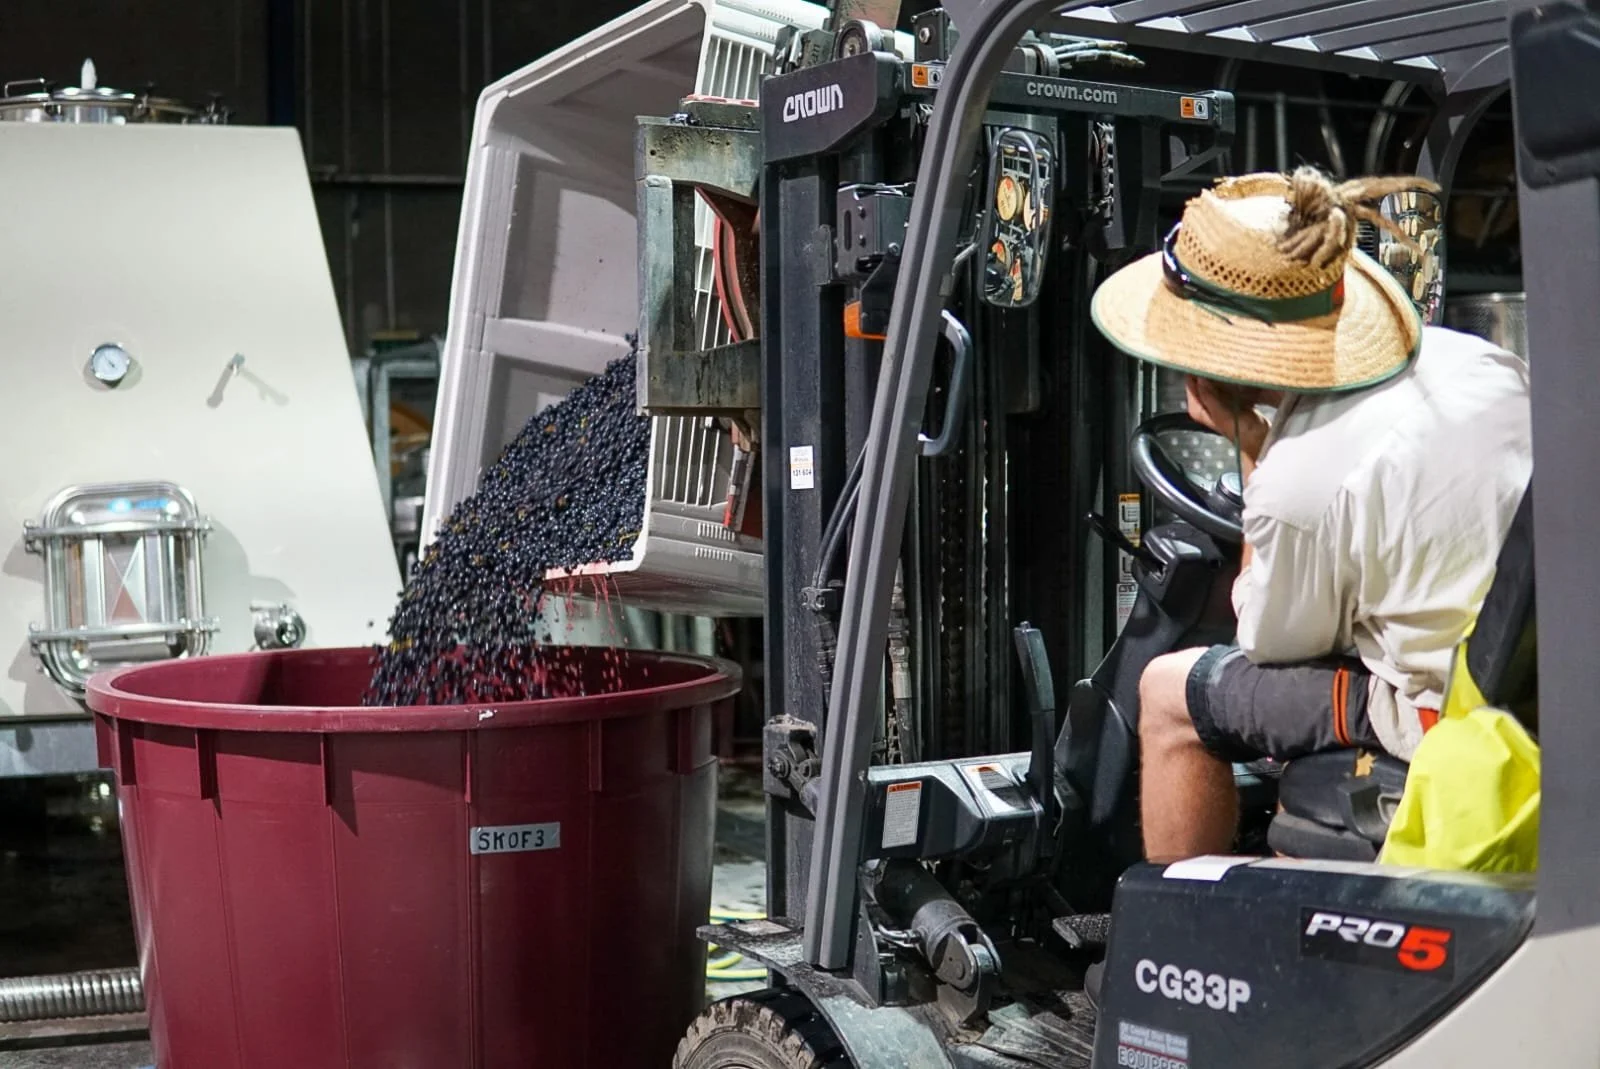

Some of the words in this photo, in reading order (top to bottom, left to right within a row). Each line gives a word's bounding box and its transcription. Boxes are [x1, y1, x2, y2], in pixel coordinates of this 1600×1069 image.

[783, 84, 843, 122] CROWN
[1026, 81, 1118, 104] crown.com
[1135, 958, 1251, 1014] CG33P
[1118, 1046, 1188, 1069] EQUIPP
